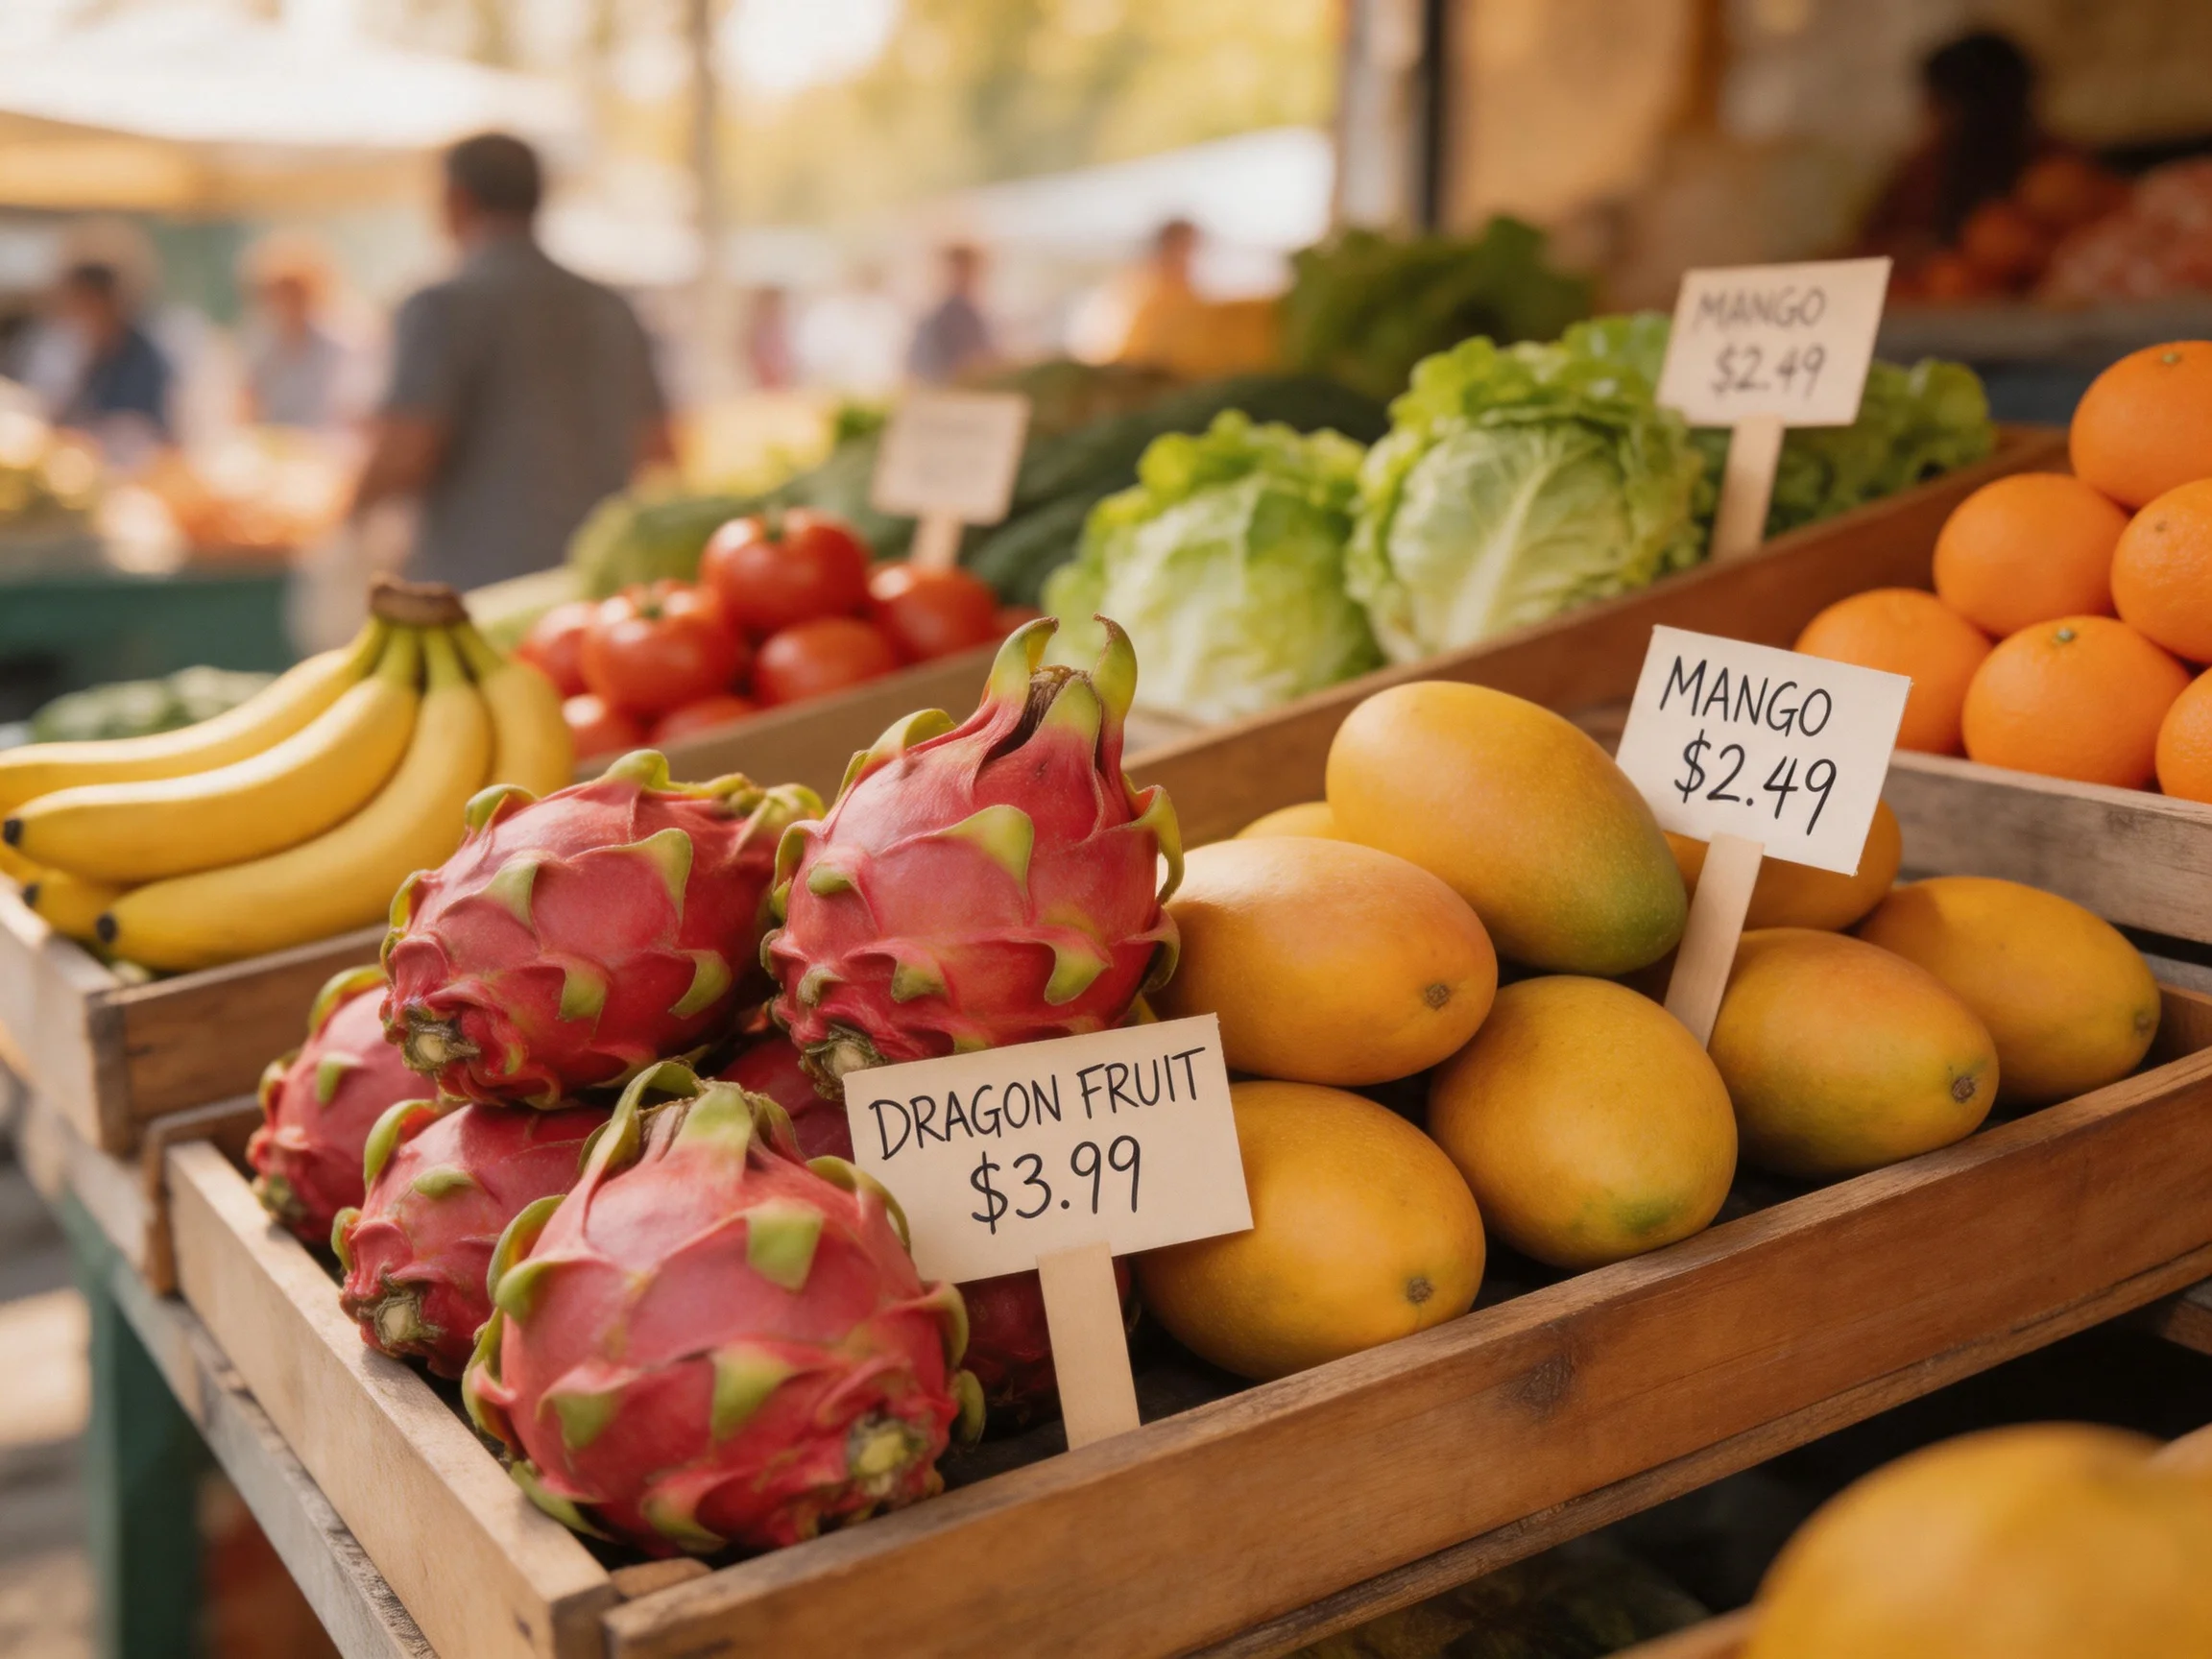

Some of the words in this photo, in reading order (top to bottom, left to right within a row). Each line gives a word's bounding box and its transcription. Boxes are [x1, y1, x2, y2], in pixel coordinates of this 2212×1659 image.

[1693, 284, 1827, 332] MANGO
[1711, 343, 1827, 399] $2.49
[1659, 655, 1833, 737] MANGO
[1673, 728, 1838, 836] $2.49
[868, 1073, 1062, 1162] DRAGON
[1075, 1046, 1206, 1120] FRUIT
[970, 1135, 1142, 1236] $3.99
